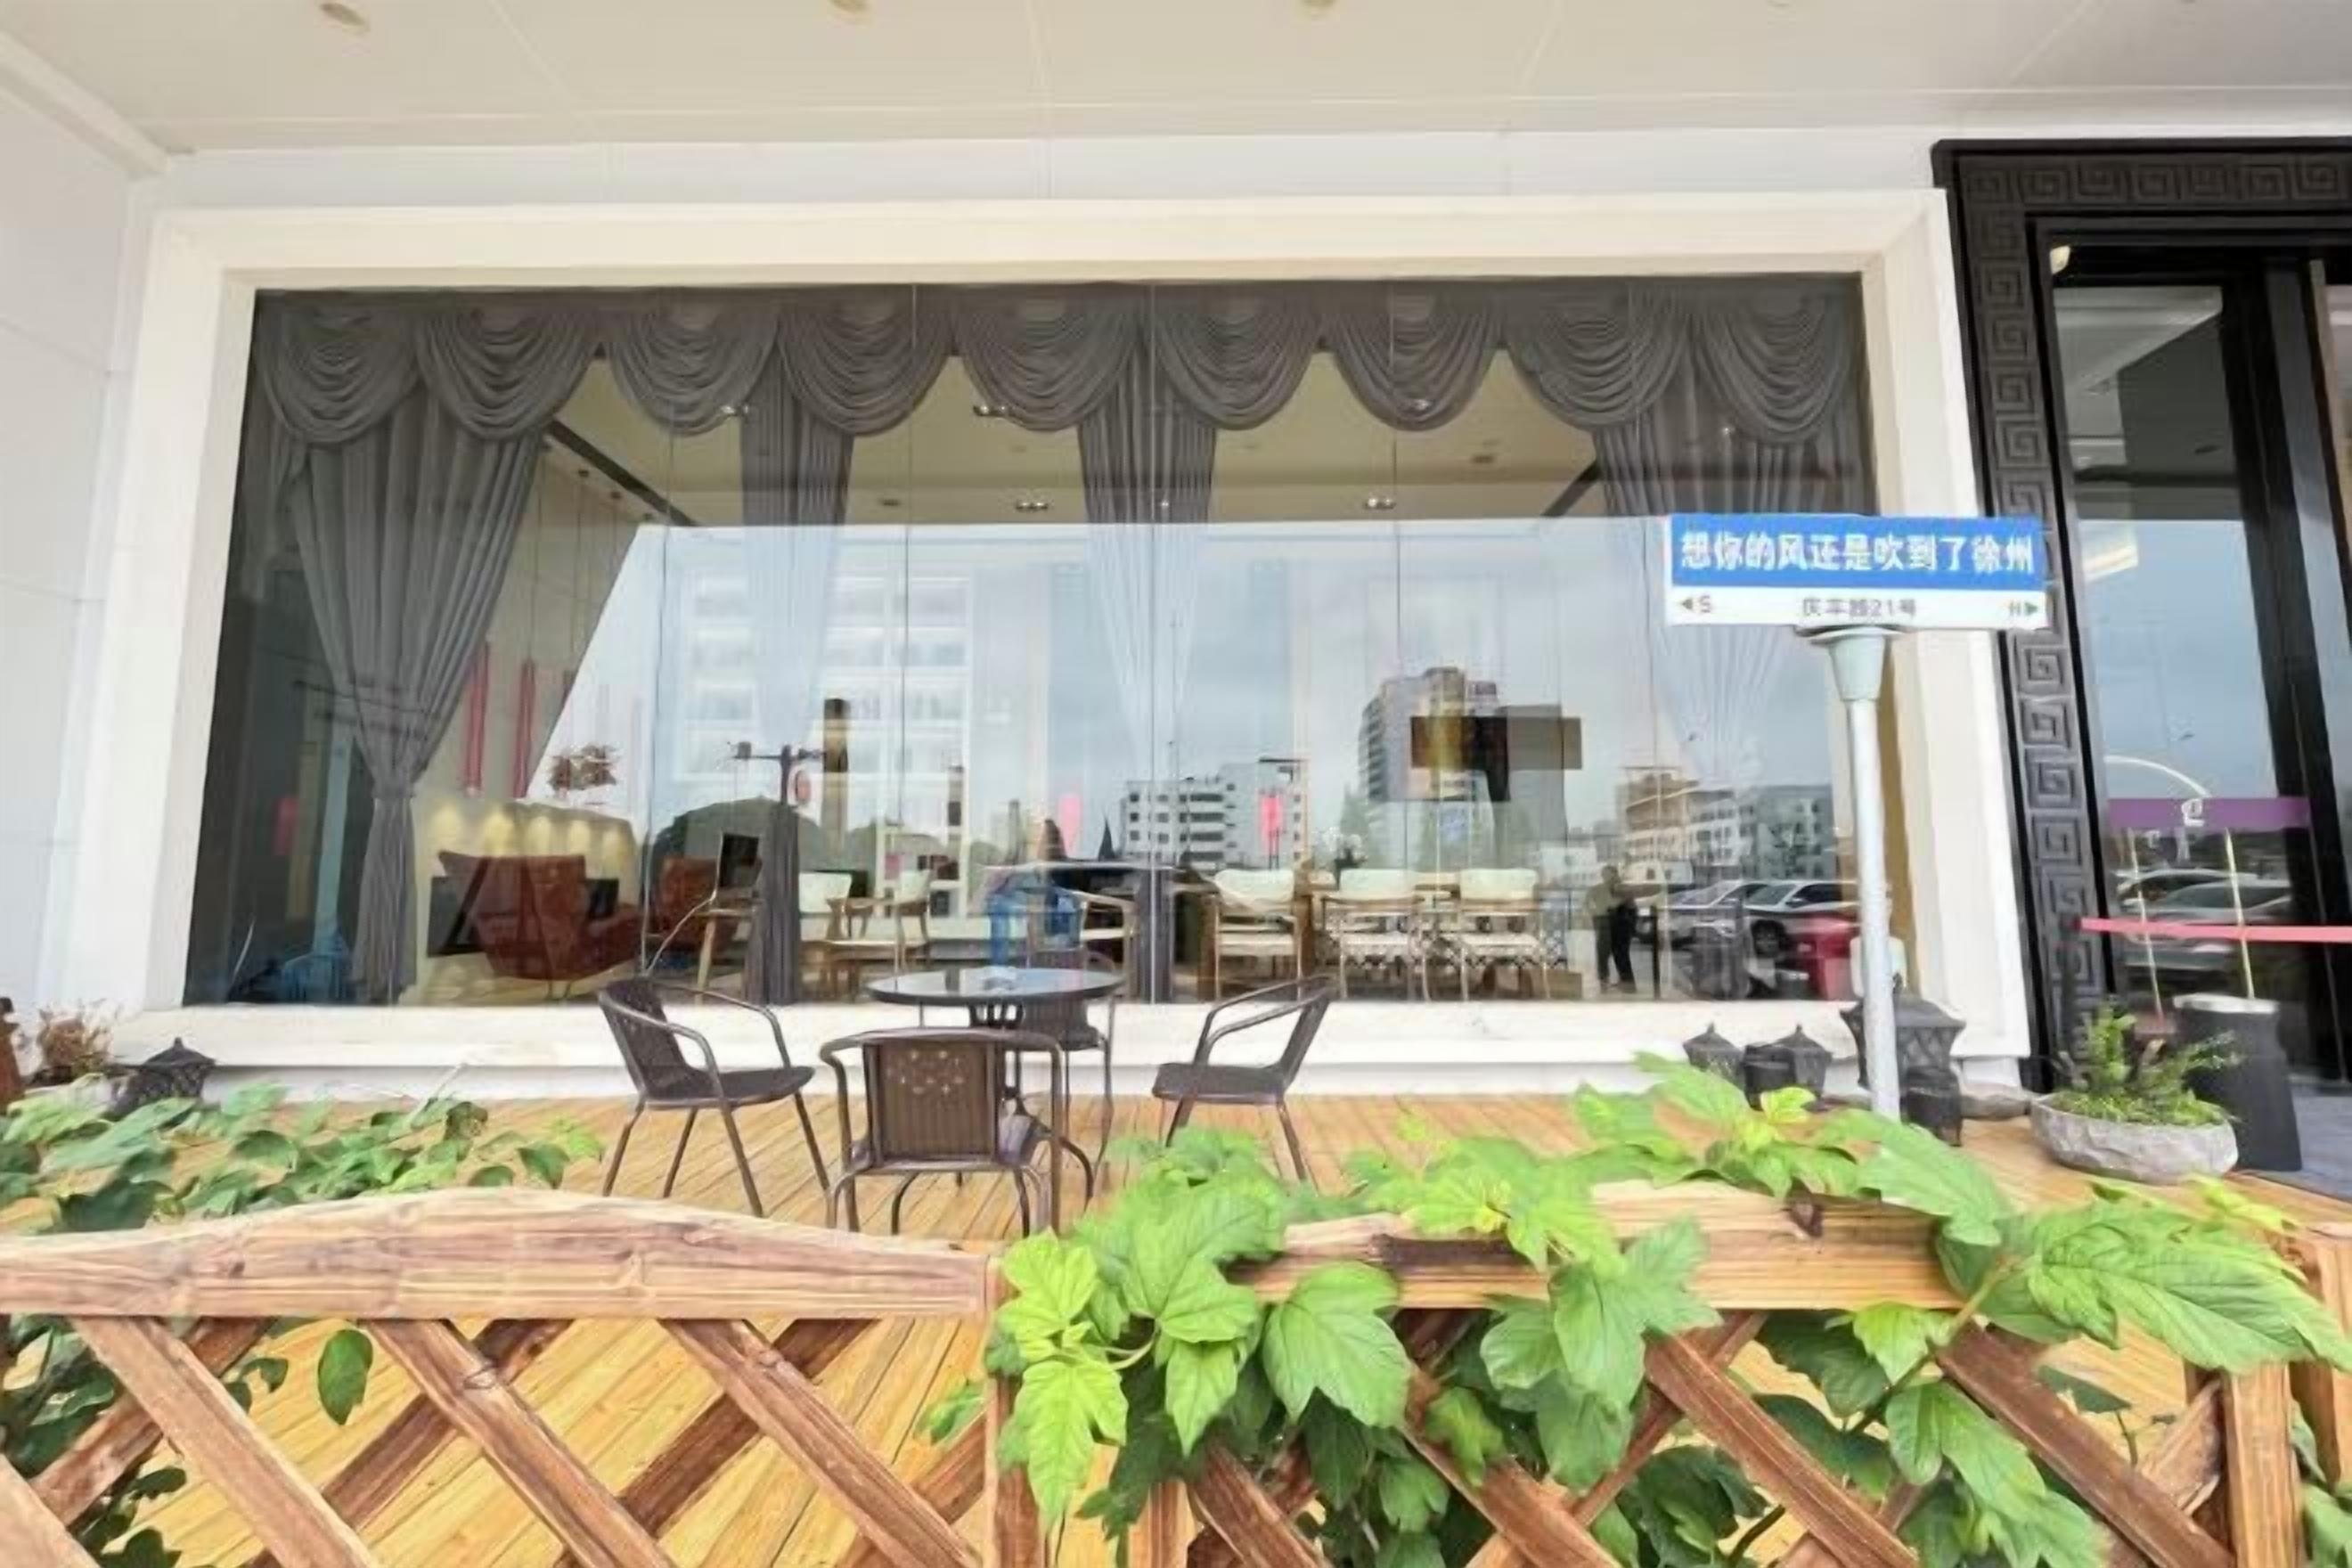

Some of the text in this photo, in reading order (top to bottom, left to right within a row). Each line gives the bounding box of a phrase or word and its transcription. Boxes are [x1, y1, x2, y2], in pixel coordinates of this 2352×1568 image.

[1681, 530, 2035, 574] 想你的风还是吹到了徐州
